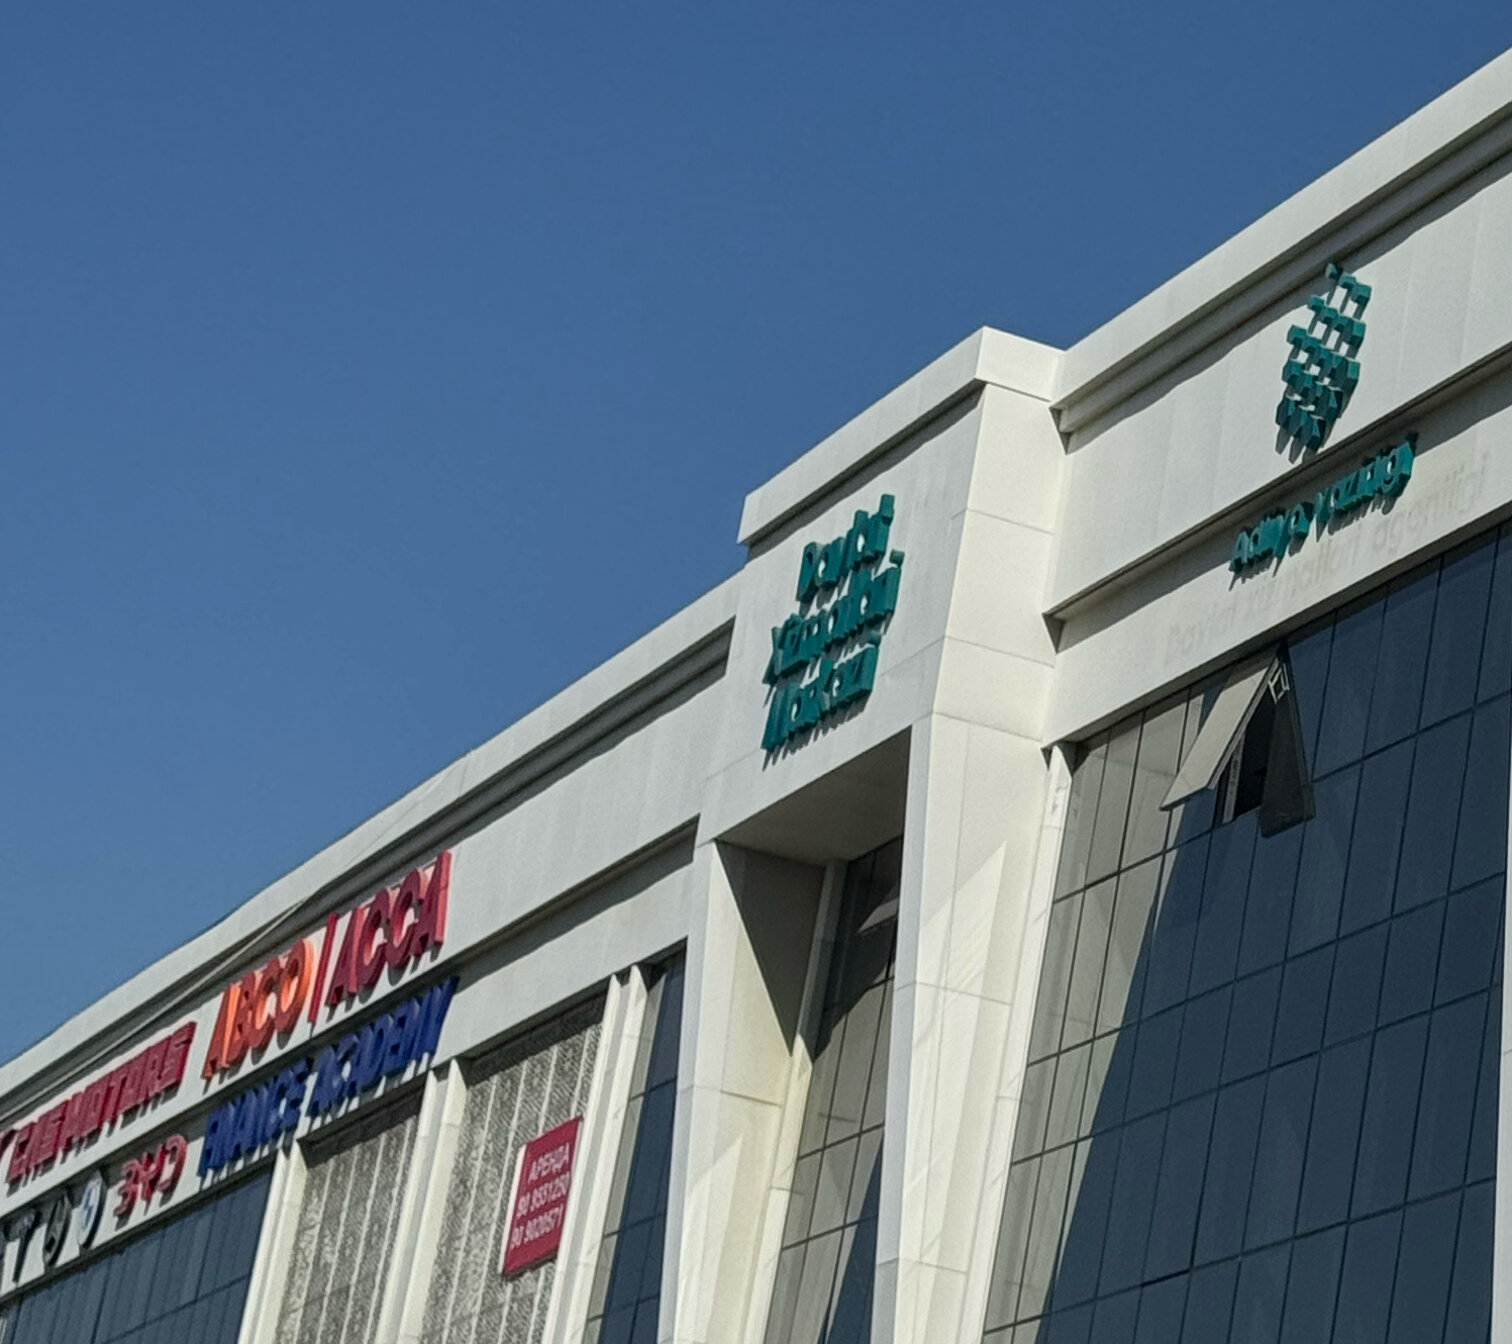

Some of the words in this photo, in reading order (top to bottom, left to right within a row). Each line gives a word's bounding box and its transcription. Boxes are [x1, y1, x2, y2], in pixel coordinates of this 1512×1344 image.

[201, 939, 314, 1080] ABCO
[326, 850, 452, 1008] ACCA
[307, 976, 459, 1118] ACADEMY
